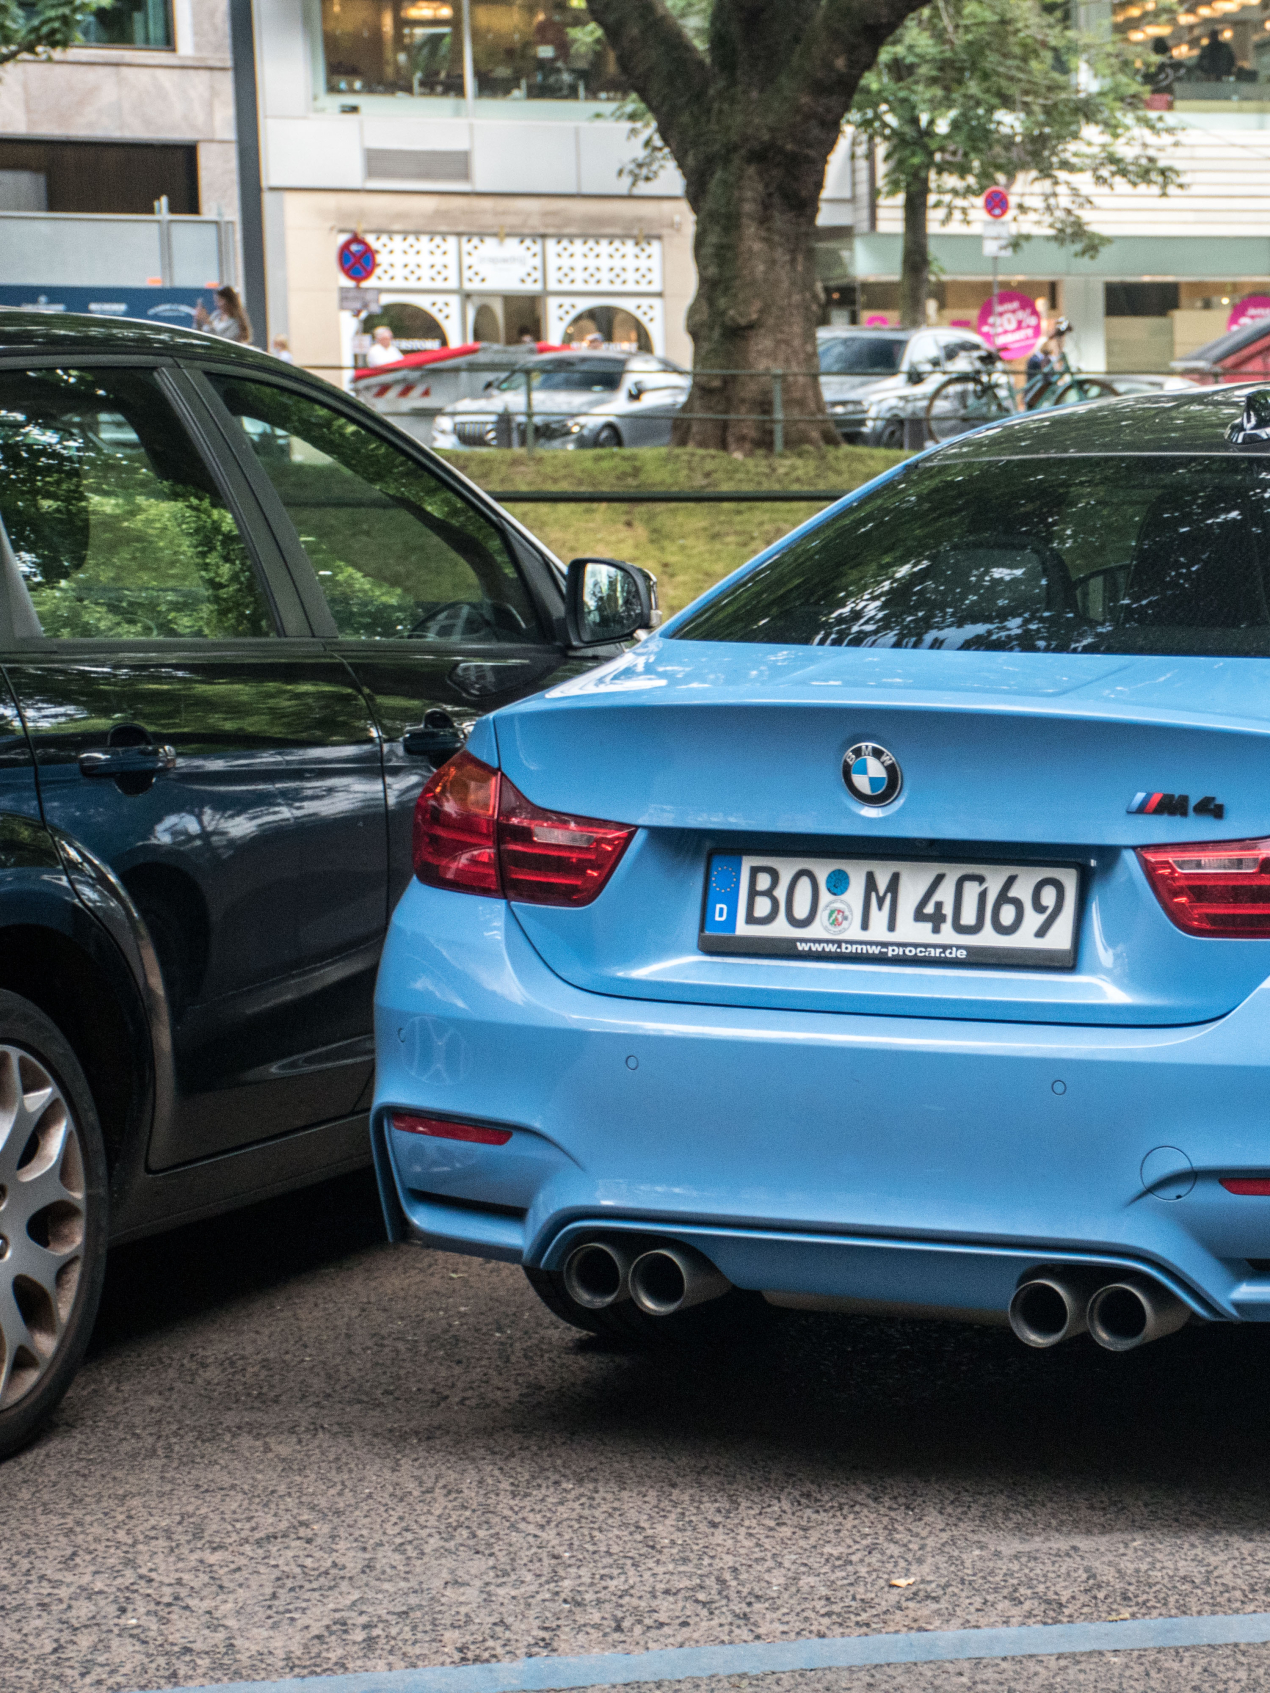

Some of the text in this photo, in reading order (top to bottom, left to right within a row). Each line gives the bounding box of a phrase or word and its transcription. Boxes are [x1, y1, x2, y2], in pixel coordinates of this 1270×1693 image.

[845, 745, 893, 767] BMW
[1138, 793, 1225, 820] M4
[714, 903, 727, 922] D
[744, 865, 819, 928] BO
[860, 870, 900, 932] M
[913, 873, 1065, 939] 4069
[796, 941, 968, 959] www.bmw-procar.de
